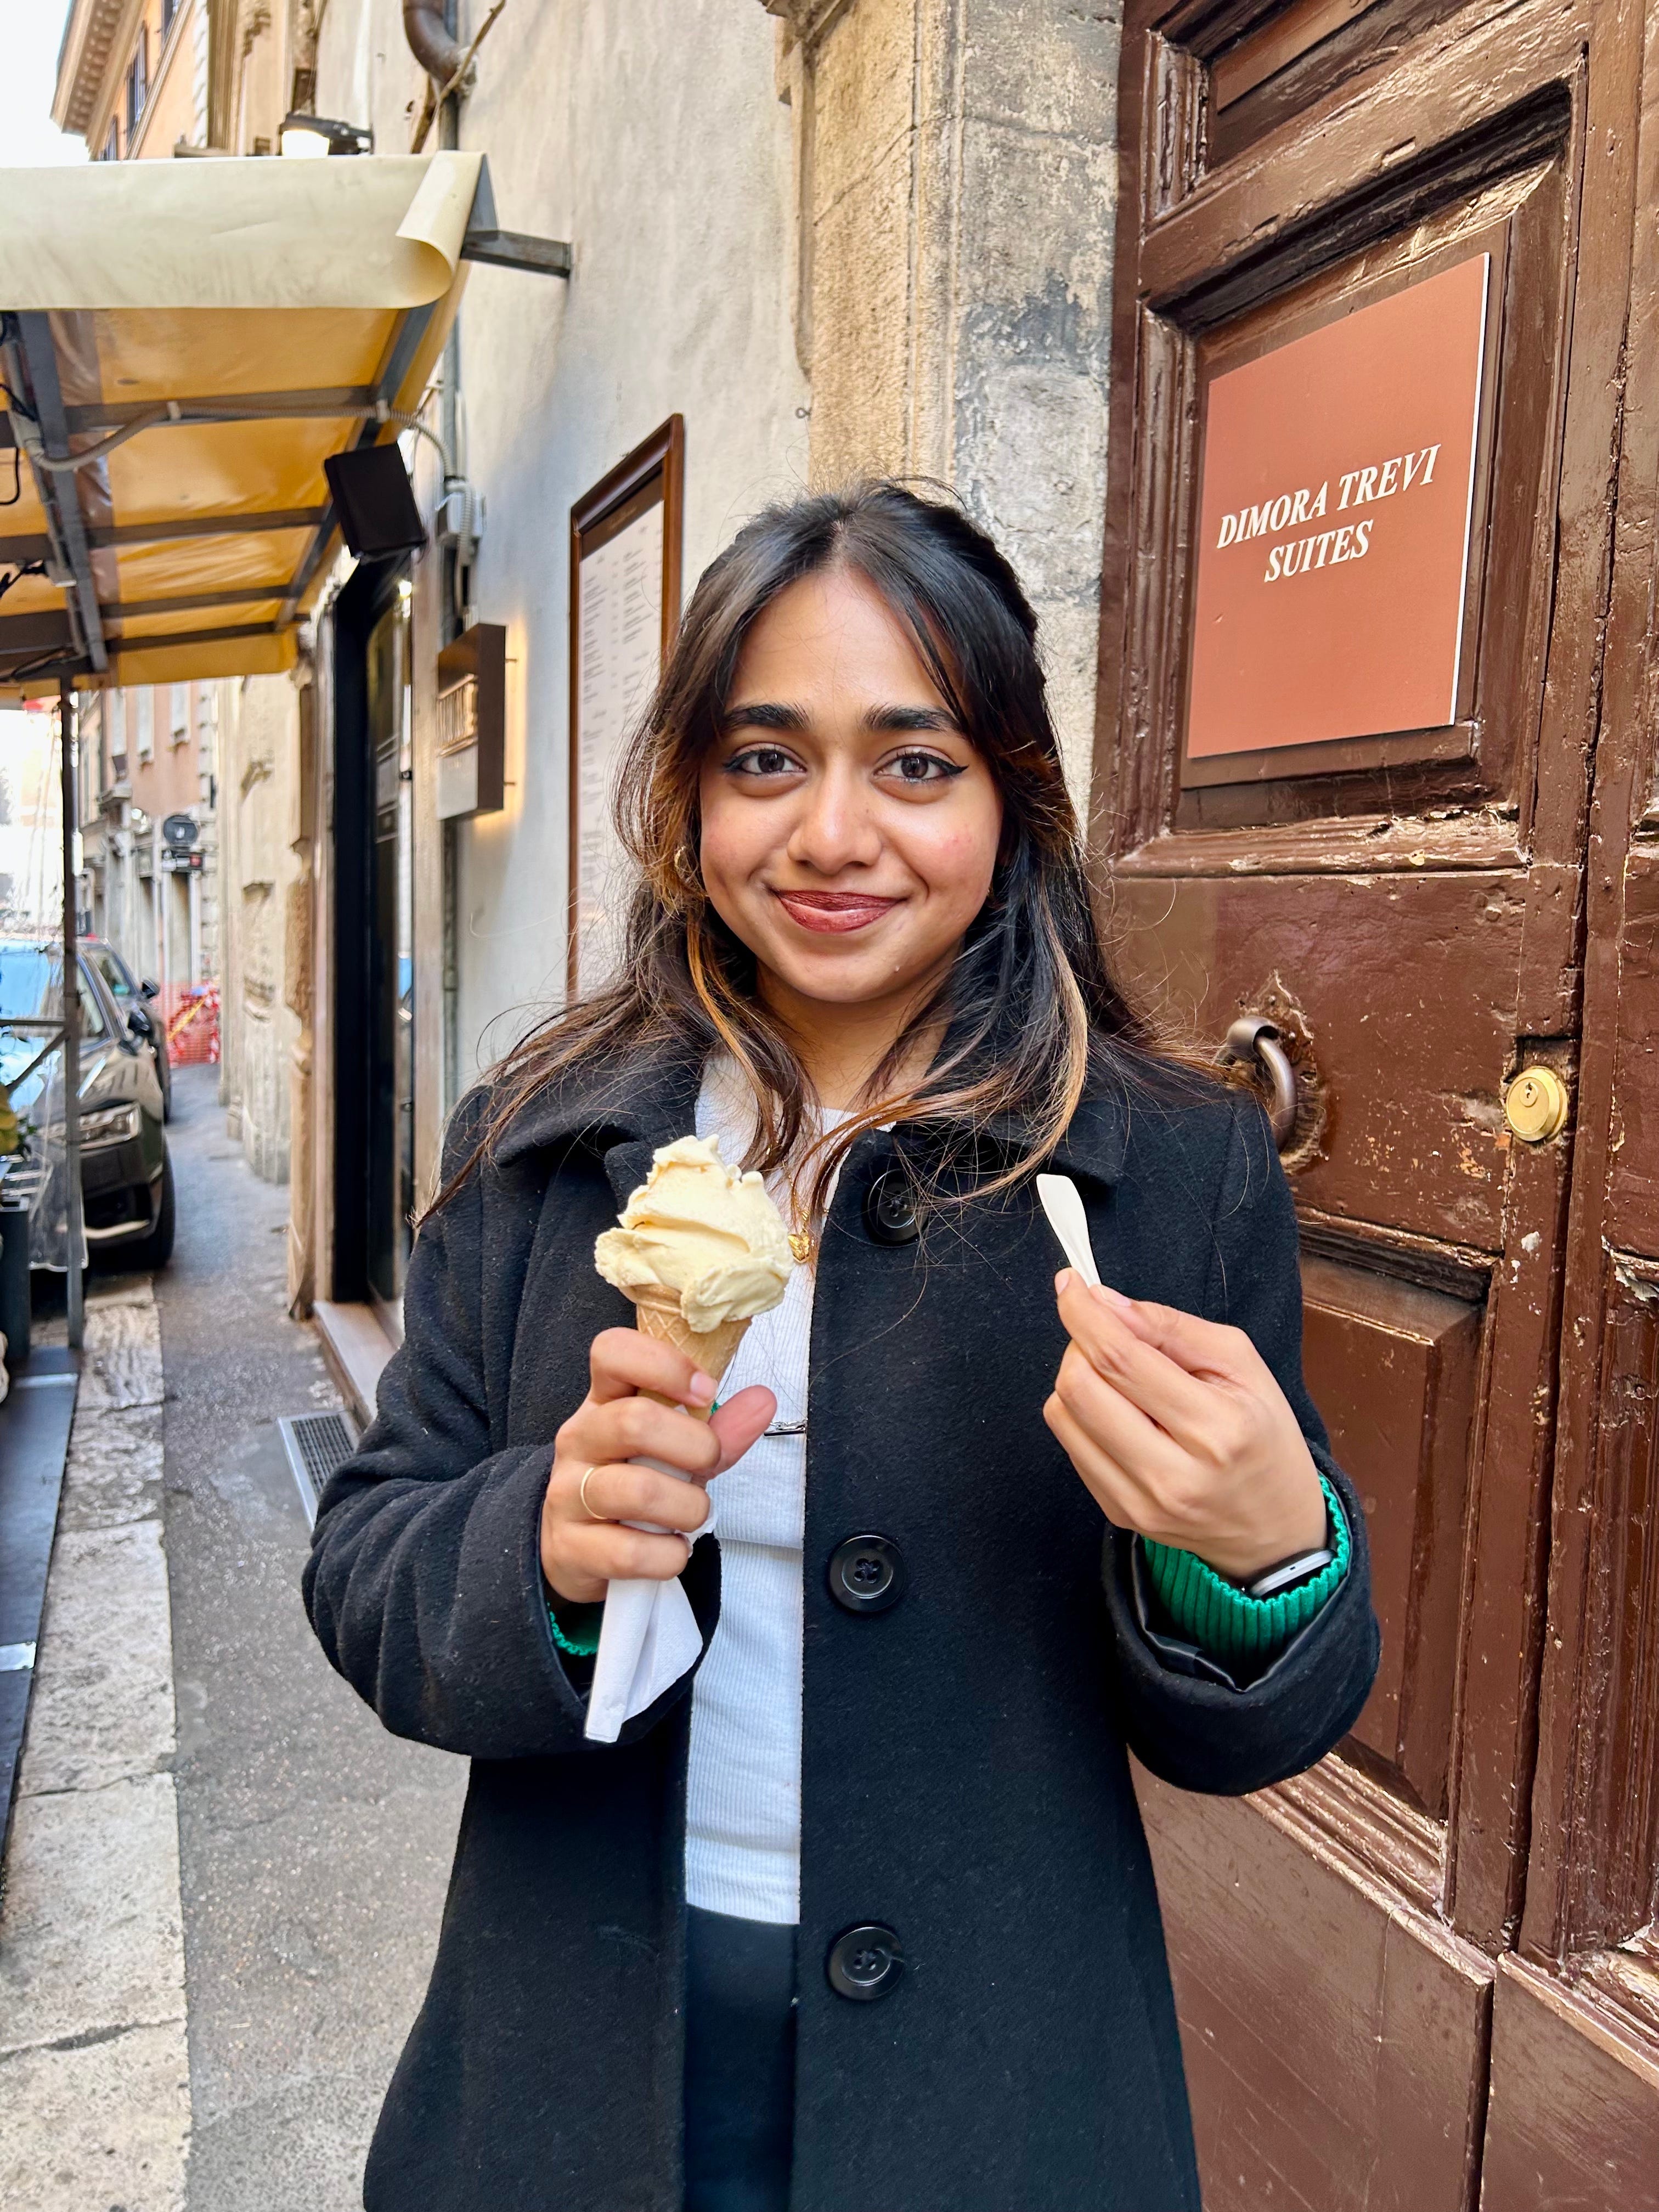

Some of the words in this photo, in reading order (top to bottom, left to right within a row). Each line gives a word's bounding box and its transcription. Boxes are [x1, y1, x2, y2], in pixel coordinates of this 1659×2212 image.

[1216, 481, 1328, 549] DIMORA
[1336, 443, 1442, 511] TREVI
[1264, 519, 1374, 583] SUITES
